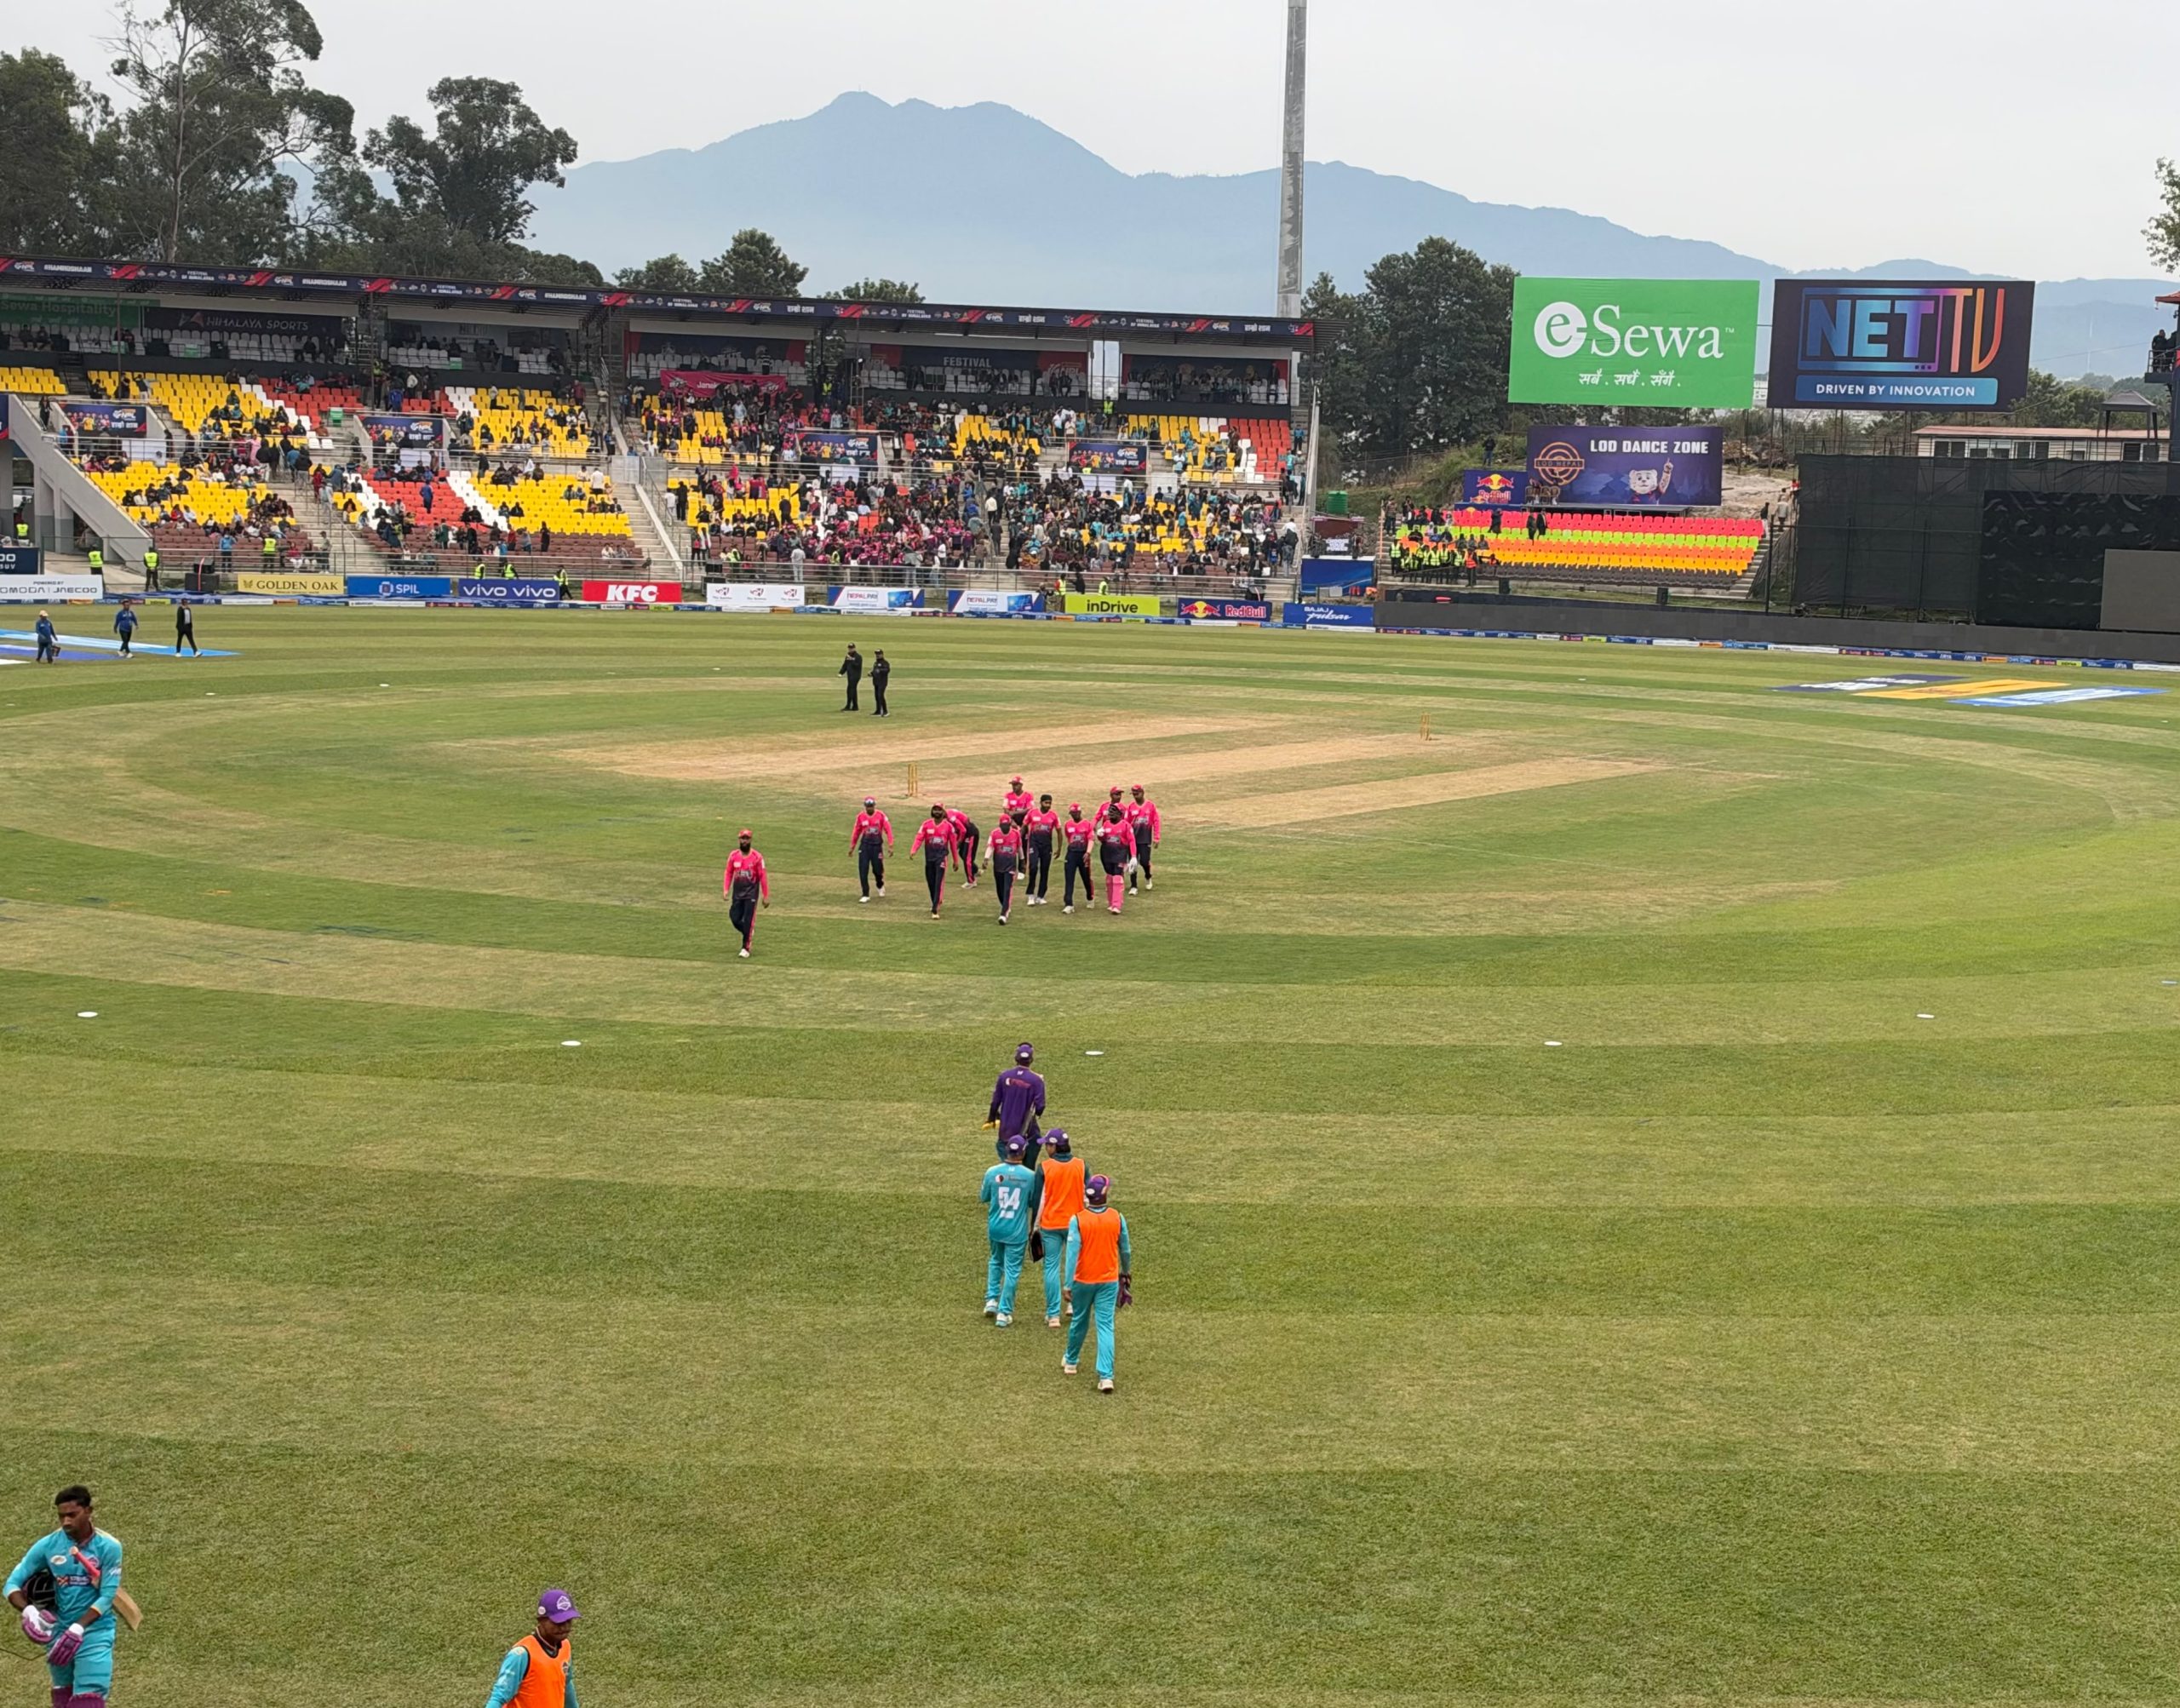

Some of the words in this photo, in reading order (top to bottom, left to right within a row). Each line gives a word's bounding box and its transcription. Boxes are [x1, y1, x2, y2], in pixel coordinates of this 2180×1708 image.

[43, 300, 117, 318] Hospitality
[207, 316, 261, 329] HIMALAYA
[267, 320, 308, 330] SPORTS
[1816, 383, 1864, 394] DRIVEN
[1868, 384, 1885, 396] BY
[1890, 385, 1975, 397] INNOVATION
[1590, 439, 1617, 453] LOD
[1622, 440, 1668, 454] DANCE
[1673, 441, 1709, 455] ZONE
[256, 580, 307, 590] GOLDEN
[312, 582, 338, 591] OAK
[395, 583, 420, 594] SPIL
[463, 583, 508, 597] vivo
[513, 584, 556, 598] vivo
[606, 584, 658, 602] KFC
[1087, 599, 1139, 613] inDrive
[998, 1186, 1021, 1211] 54
